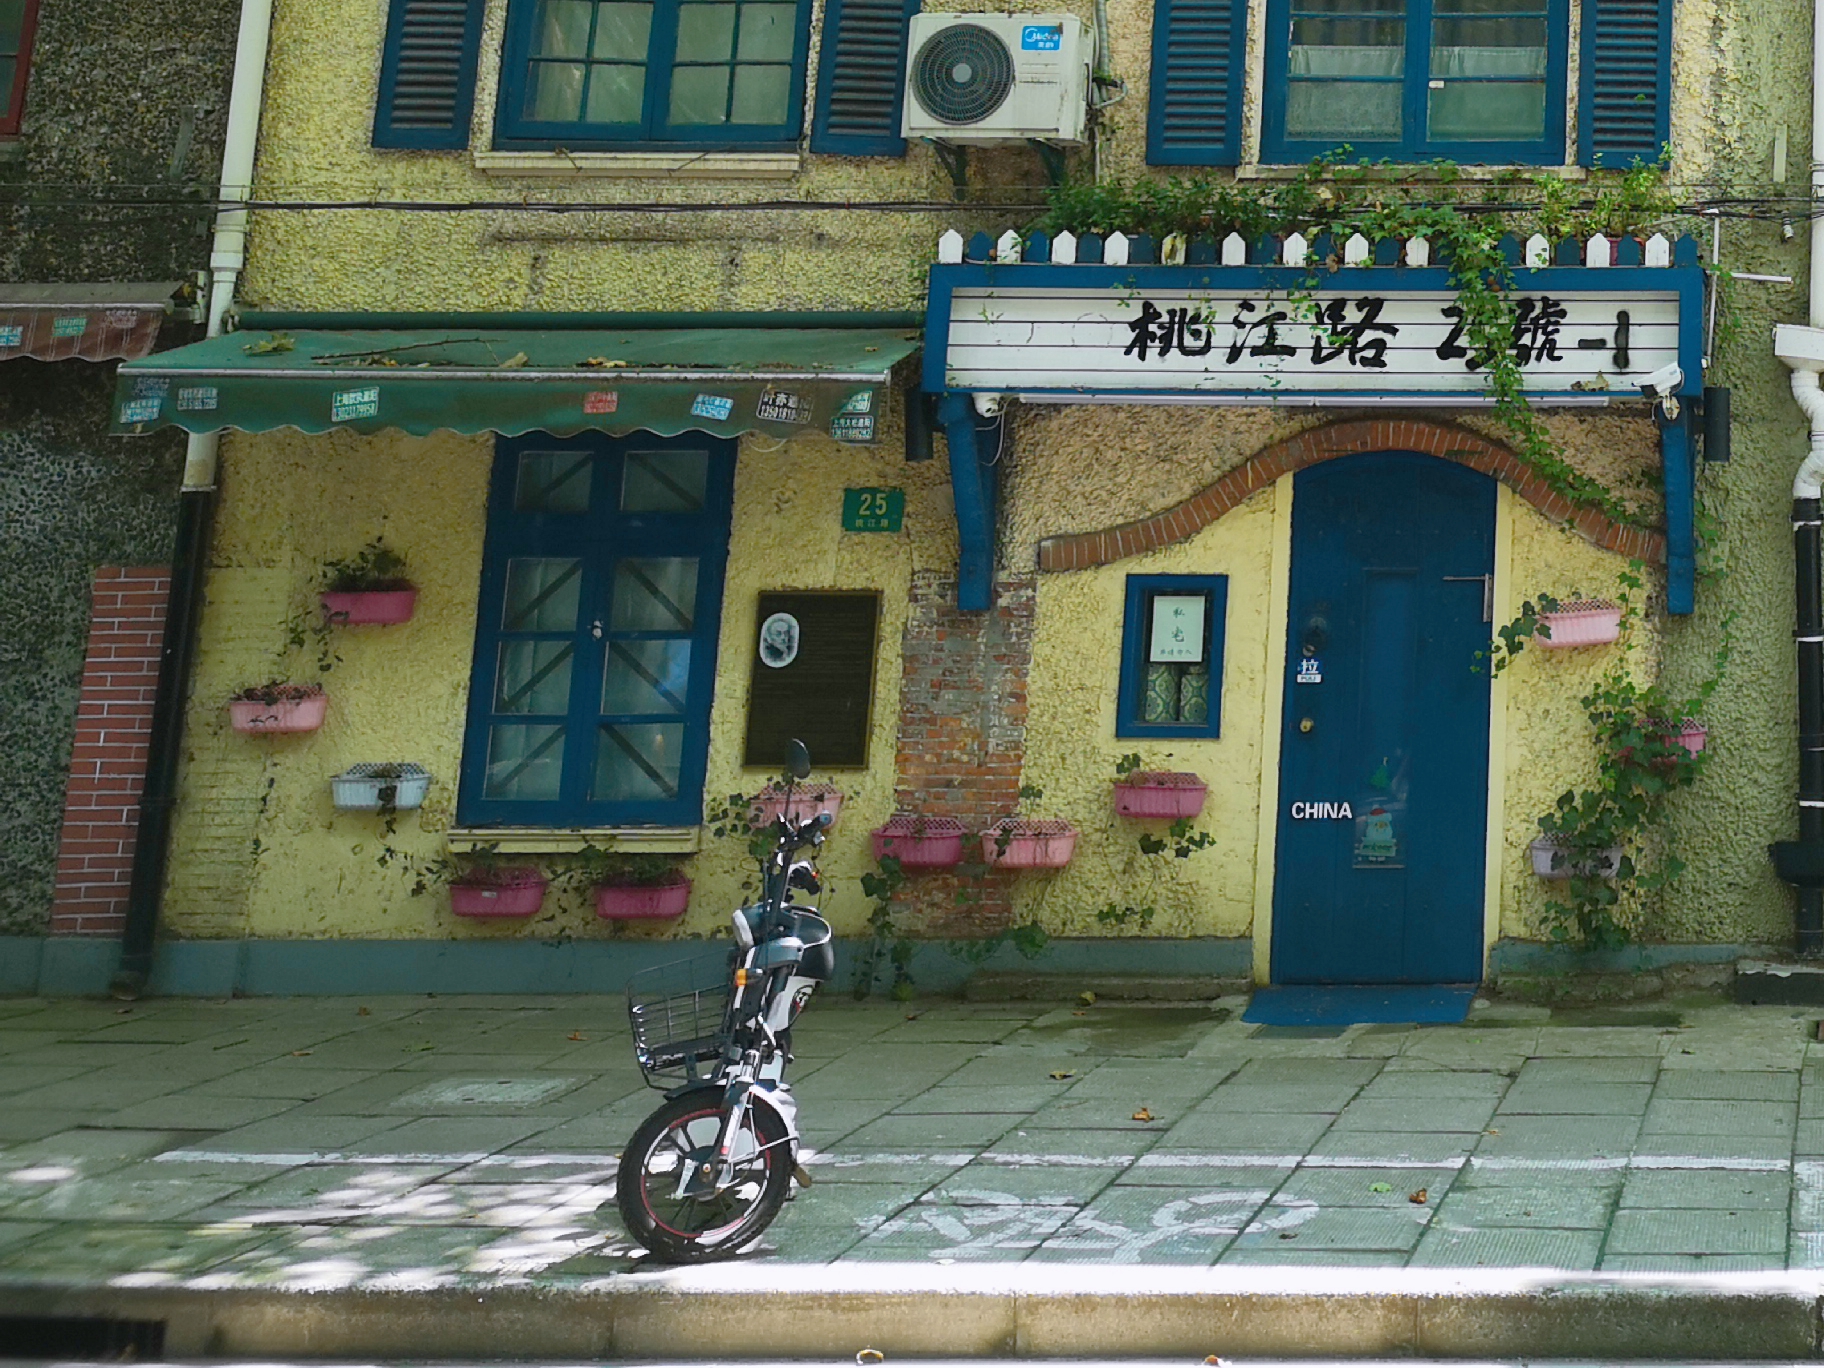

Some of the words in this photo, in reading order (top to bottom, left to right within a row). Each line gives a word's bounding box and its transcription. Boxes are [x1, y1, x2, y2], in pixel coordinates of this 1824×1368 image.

[1123, 296, 1400, 368] 桃江路
[858, 493, 887, 516] 25
[1301, 658, 1319, 675] 拉
[1291, 801, 1353, 819] CHINA
